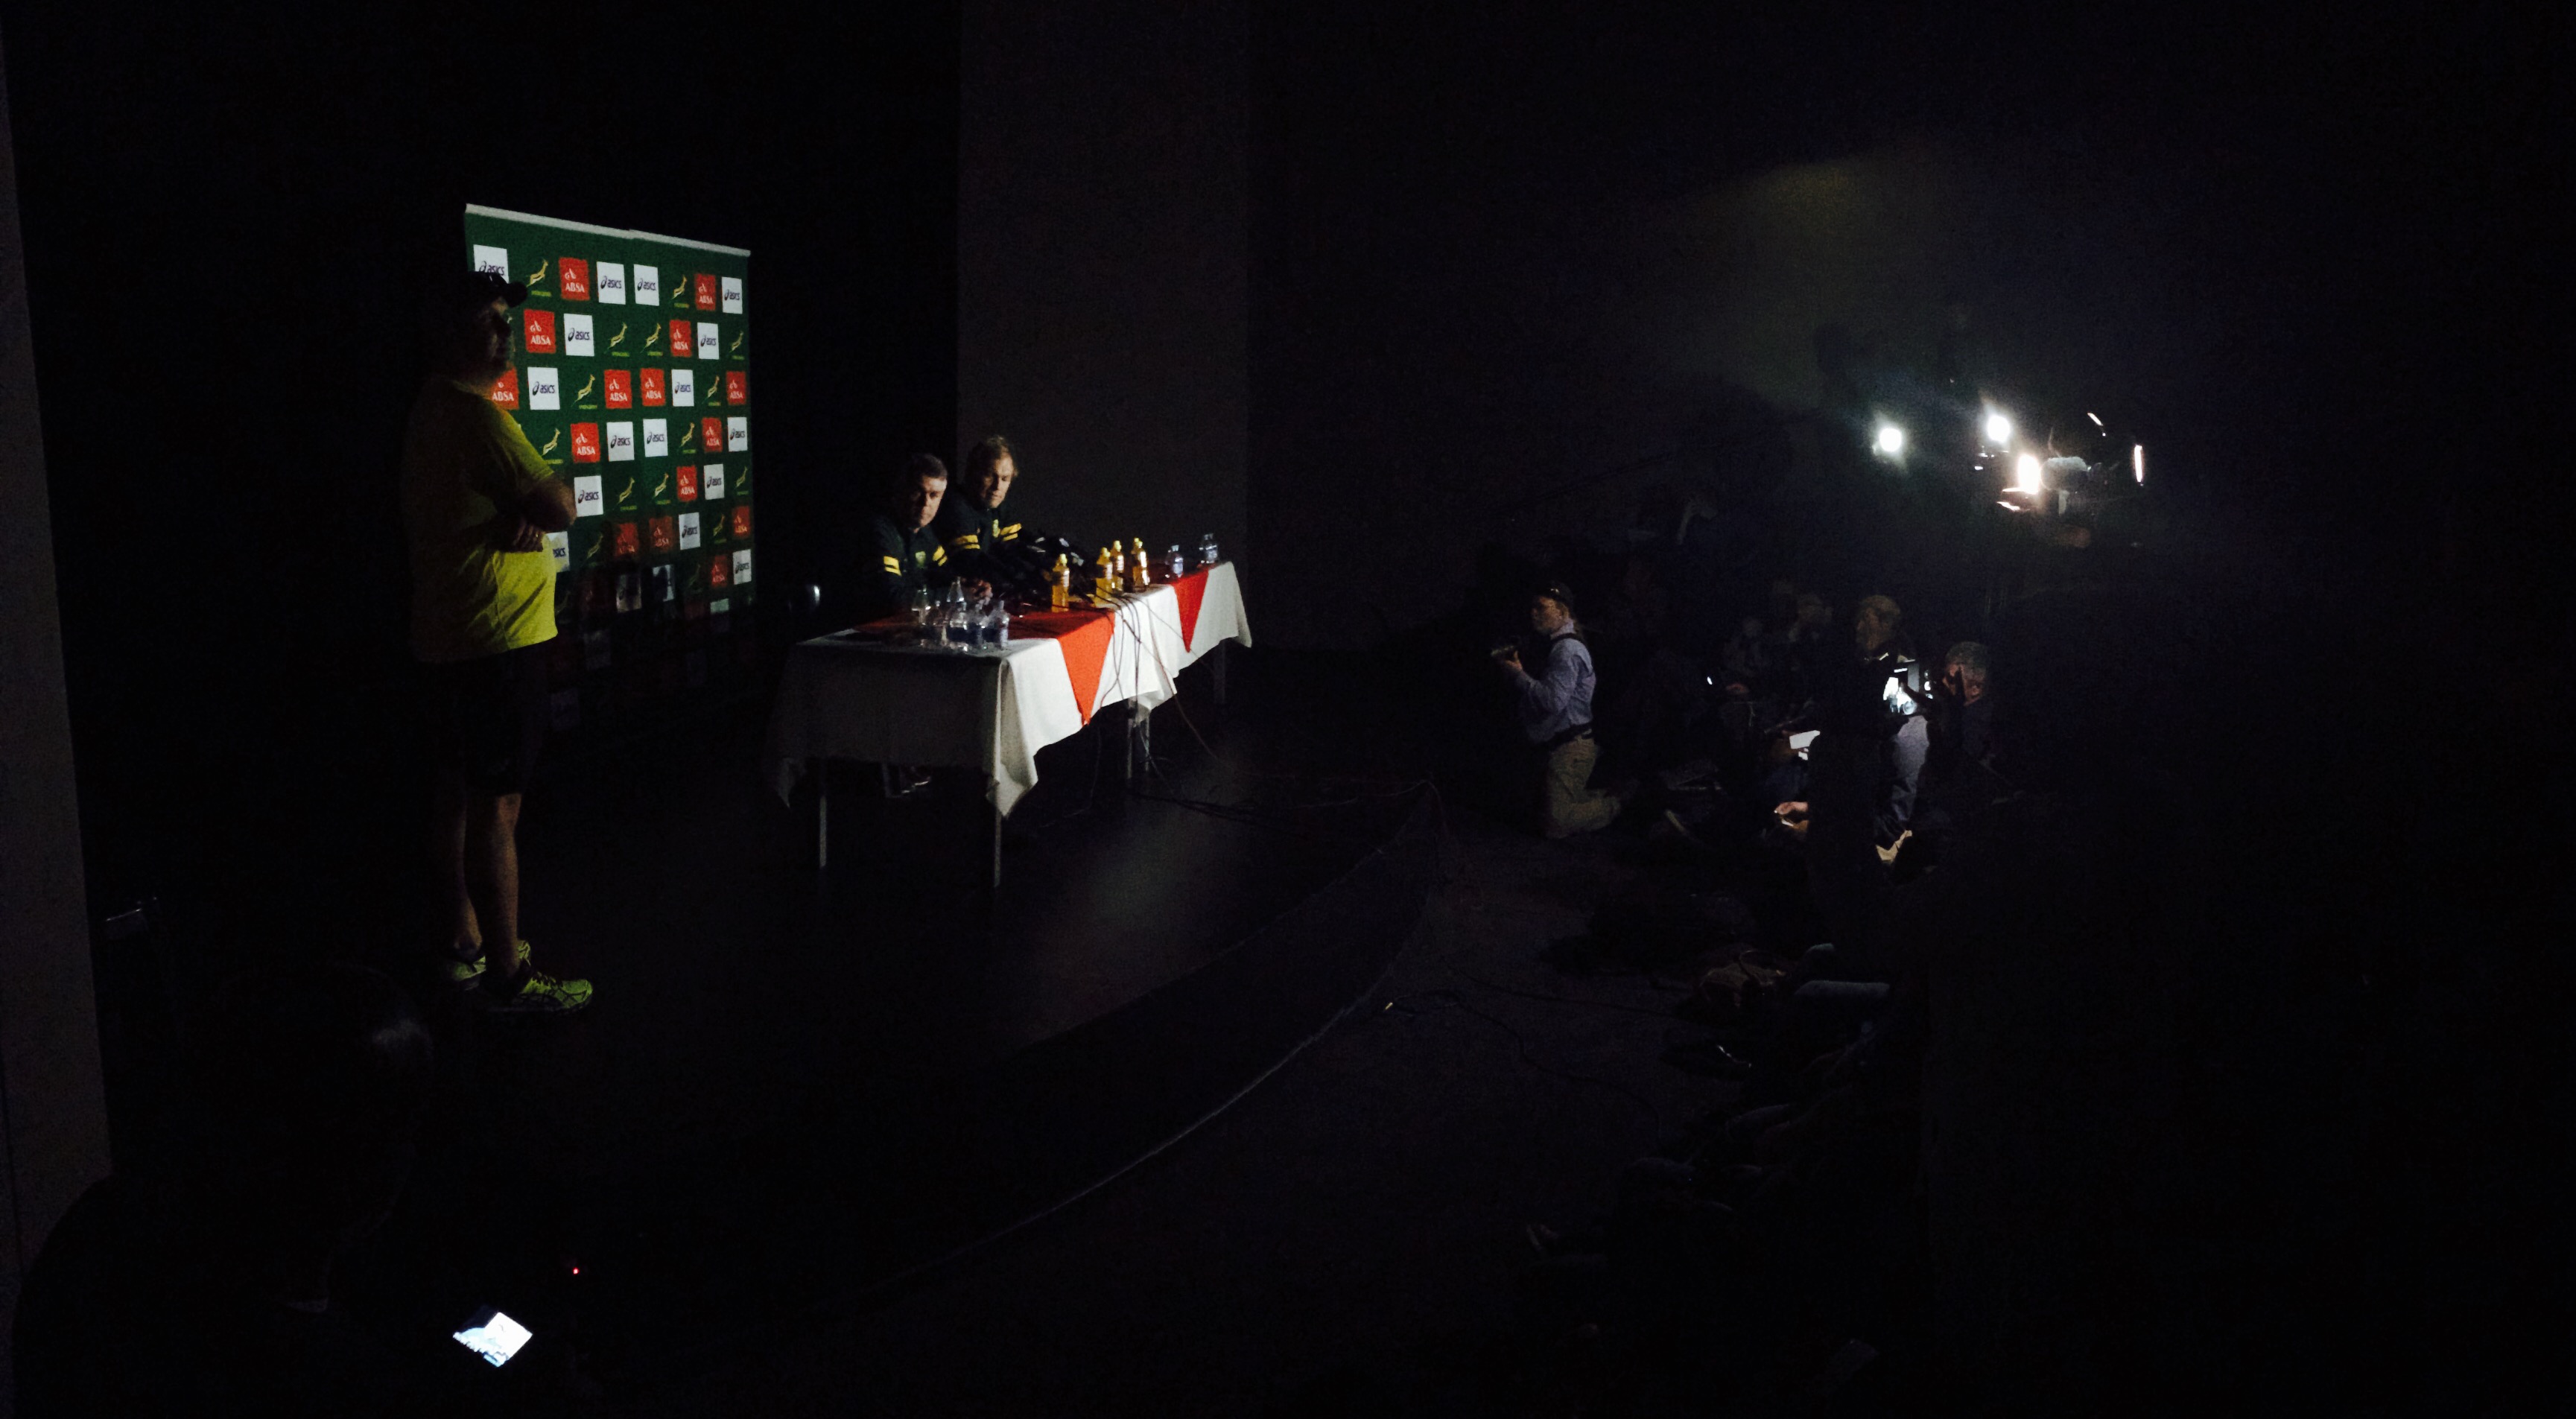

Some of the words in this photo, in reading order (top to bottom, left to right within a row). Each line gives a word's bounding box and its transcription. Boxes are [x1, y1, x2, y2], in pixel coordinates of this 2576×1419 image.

[565, 282, 585, 293] ABSA
[530, 335, 551, 346] ABSA
[673, 341, 688, 351] ABSA
[492, 391, 514, 401] ABSA
[609, 392, 628, 401] ABSA
[646, 390, 662, 399] ABSA
[577, 446, 596, 456] ABSA
